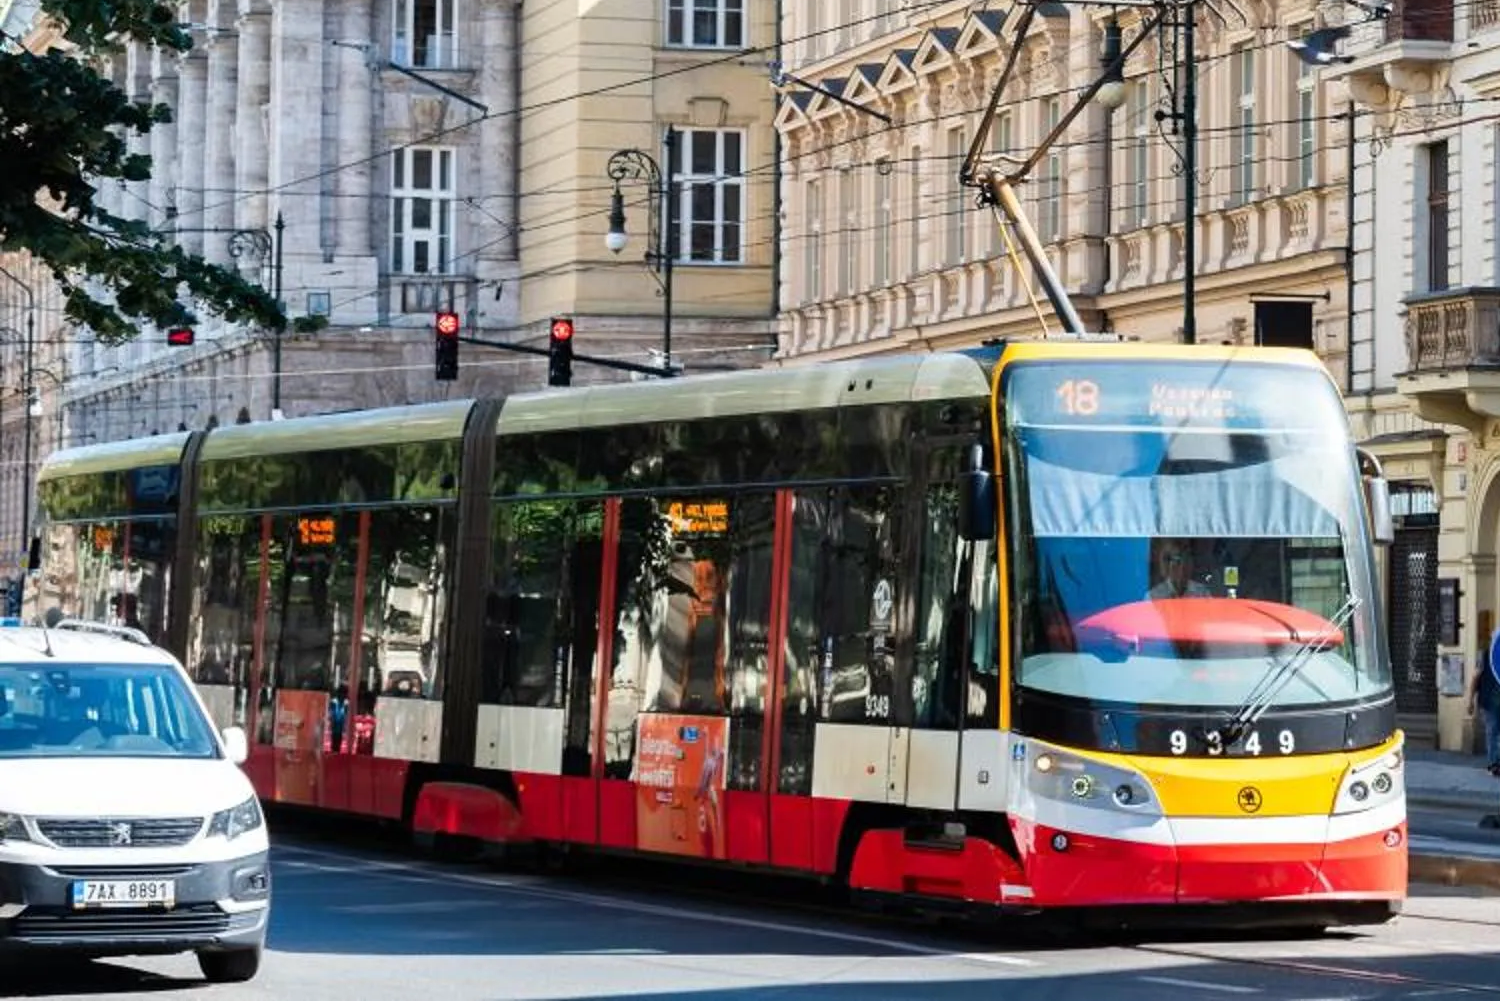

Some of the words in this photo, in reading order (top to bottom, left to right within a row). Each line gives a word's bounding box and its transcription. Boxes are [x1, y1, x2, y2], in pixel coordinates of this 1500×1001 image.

[1057, 379, 1099, 416] 18
[865, 694, 889, 718] 9349
[87, 883, 116, 900] 7AX
[128, 882, 167, 900] 8891
